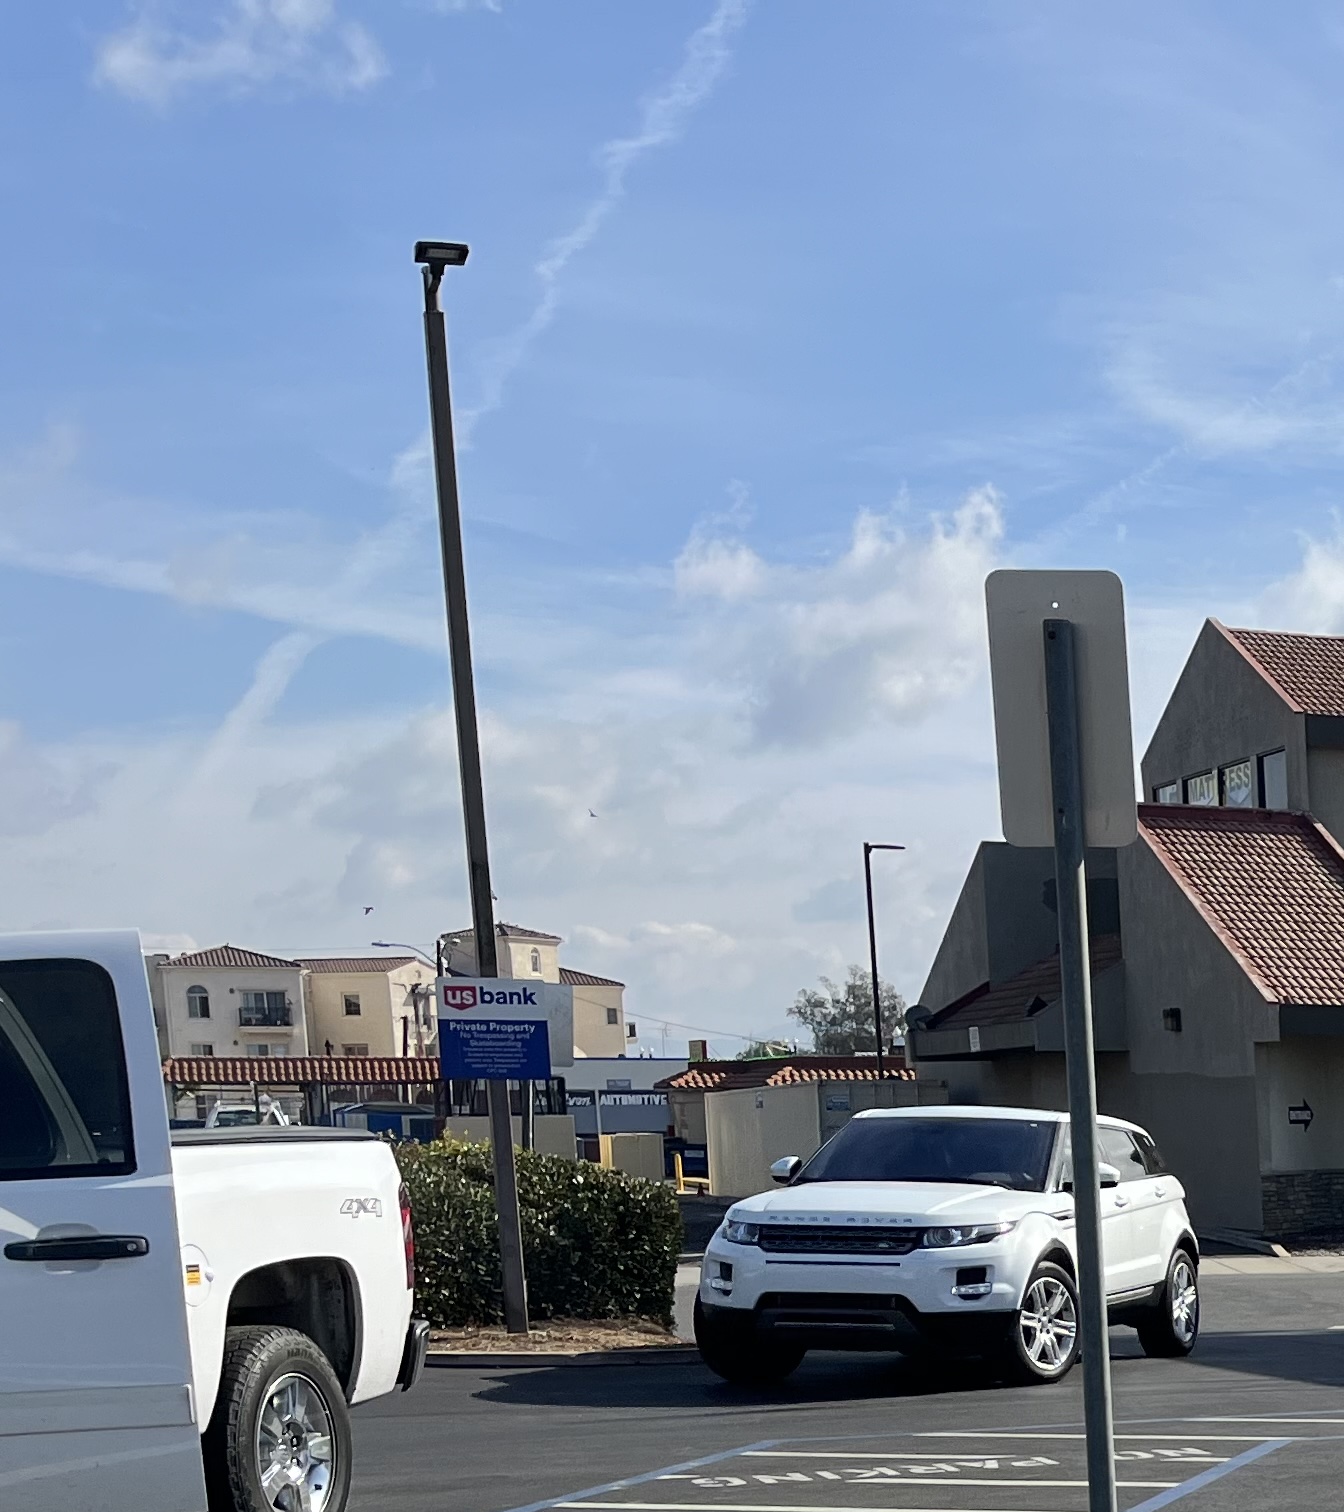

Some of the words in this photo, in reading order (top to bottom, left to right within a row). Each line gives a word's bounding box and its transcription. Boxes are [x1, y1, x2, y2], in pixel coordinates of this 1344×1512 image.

[449, 1021, 487, 1031] Private
[489, 1022, 535, 1033] Property
[600, 1094, 667, 1106] AUTOMOTIVE
[692, 1456, 1061, 1488] PARKING
